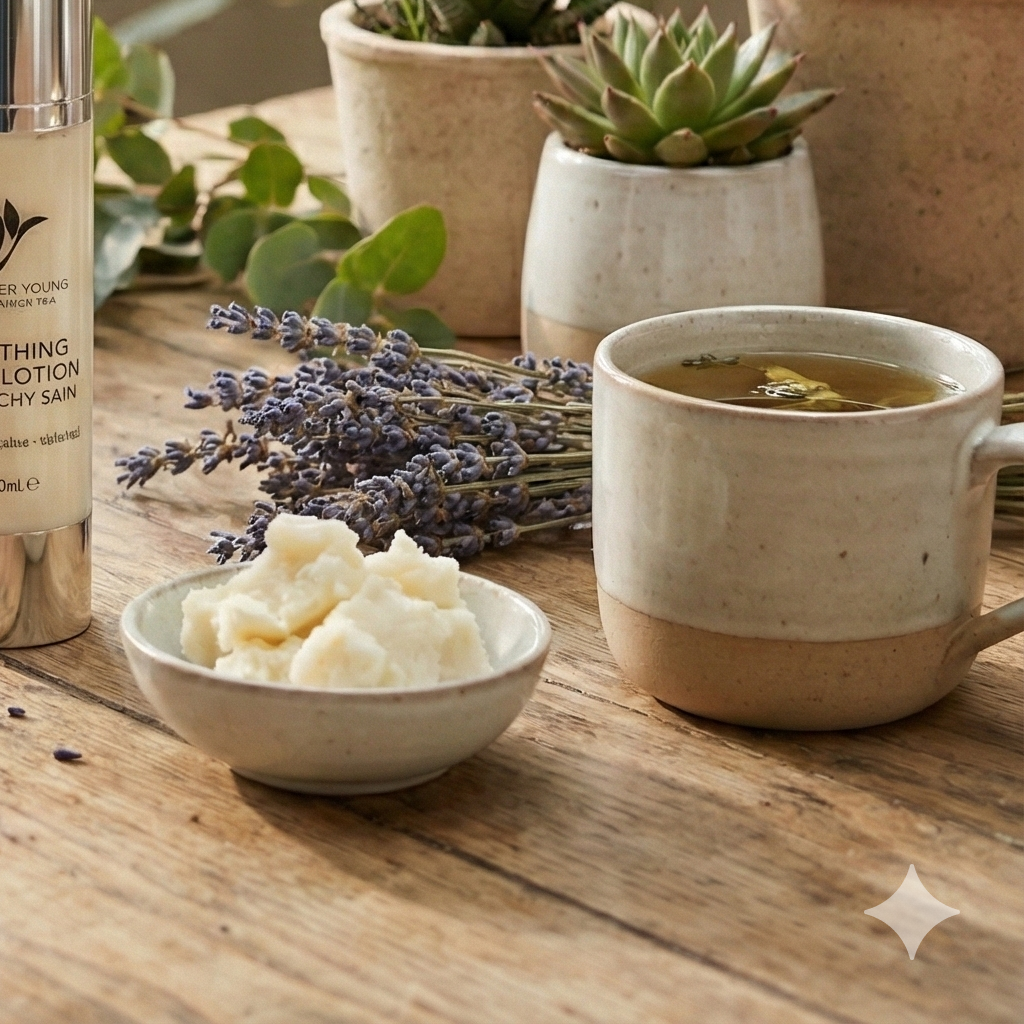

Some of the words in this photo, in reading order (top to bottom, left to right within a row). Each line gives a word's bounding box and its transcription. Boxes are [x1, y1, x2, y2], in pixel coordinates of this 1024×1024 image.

[21, 278, 69, 294] YOUNG
[2, 358, 80, 385] LOTION
[41, 384, 77, 405] SAIN
